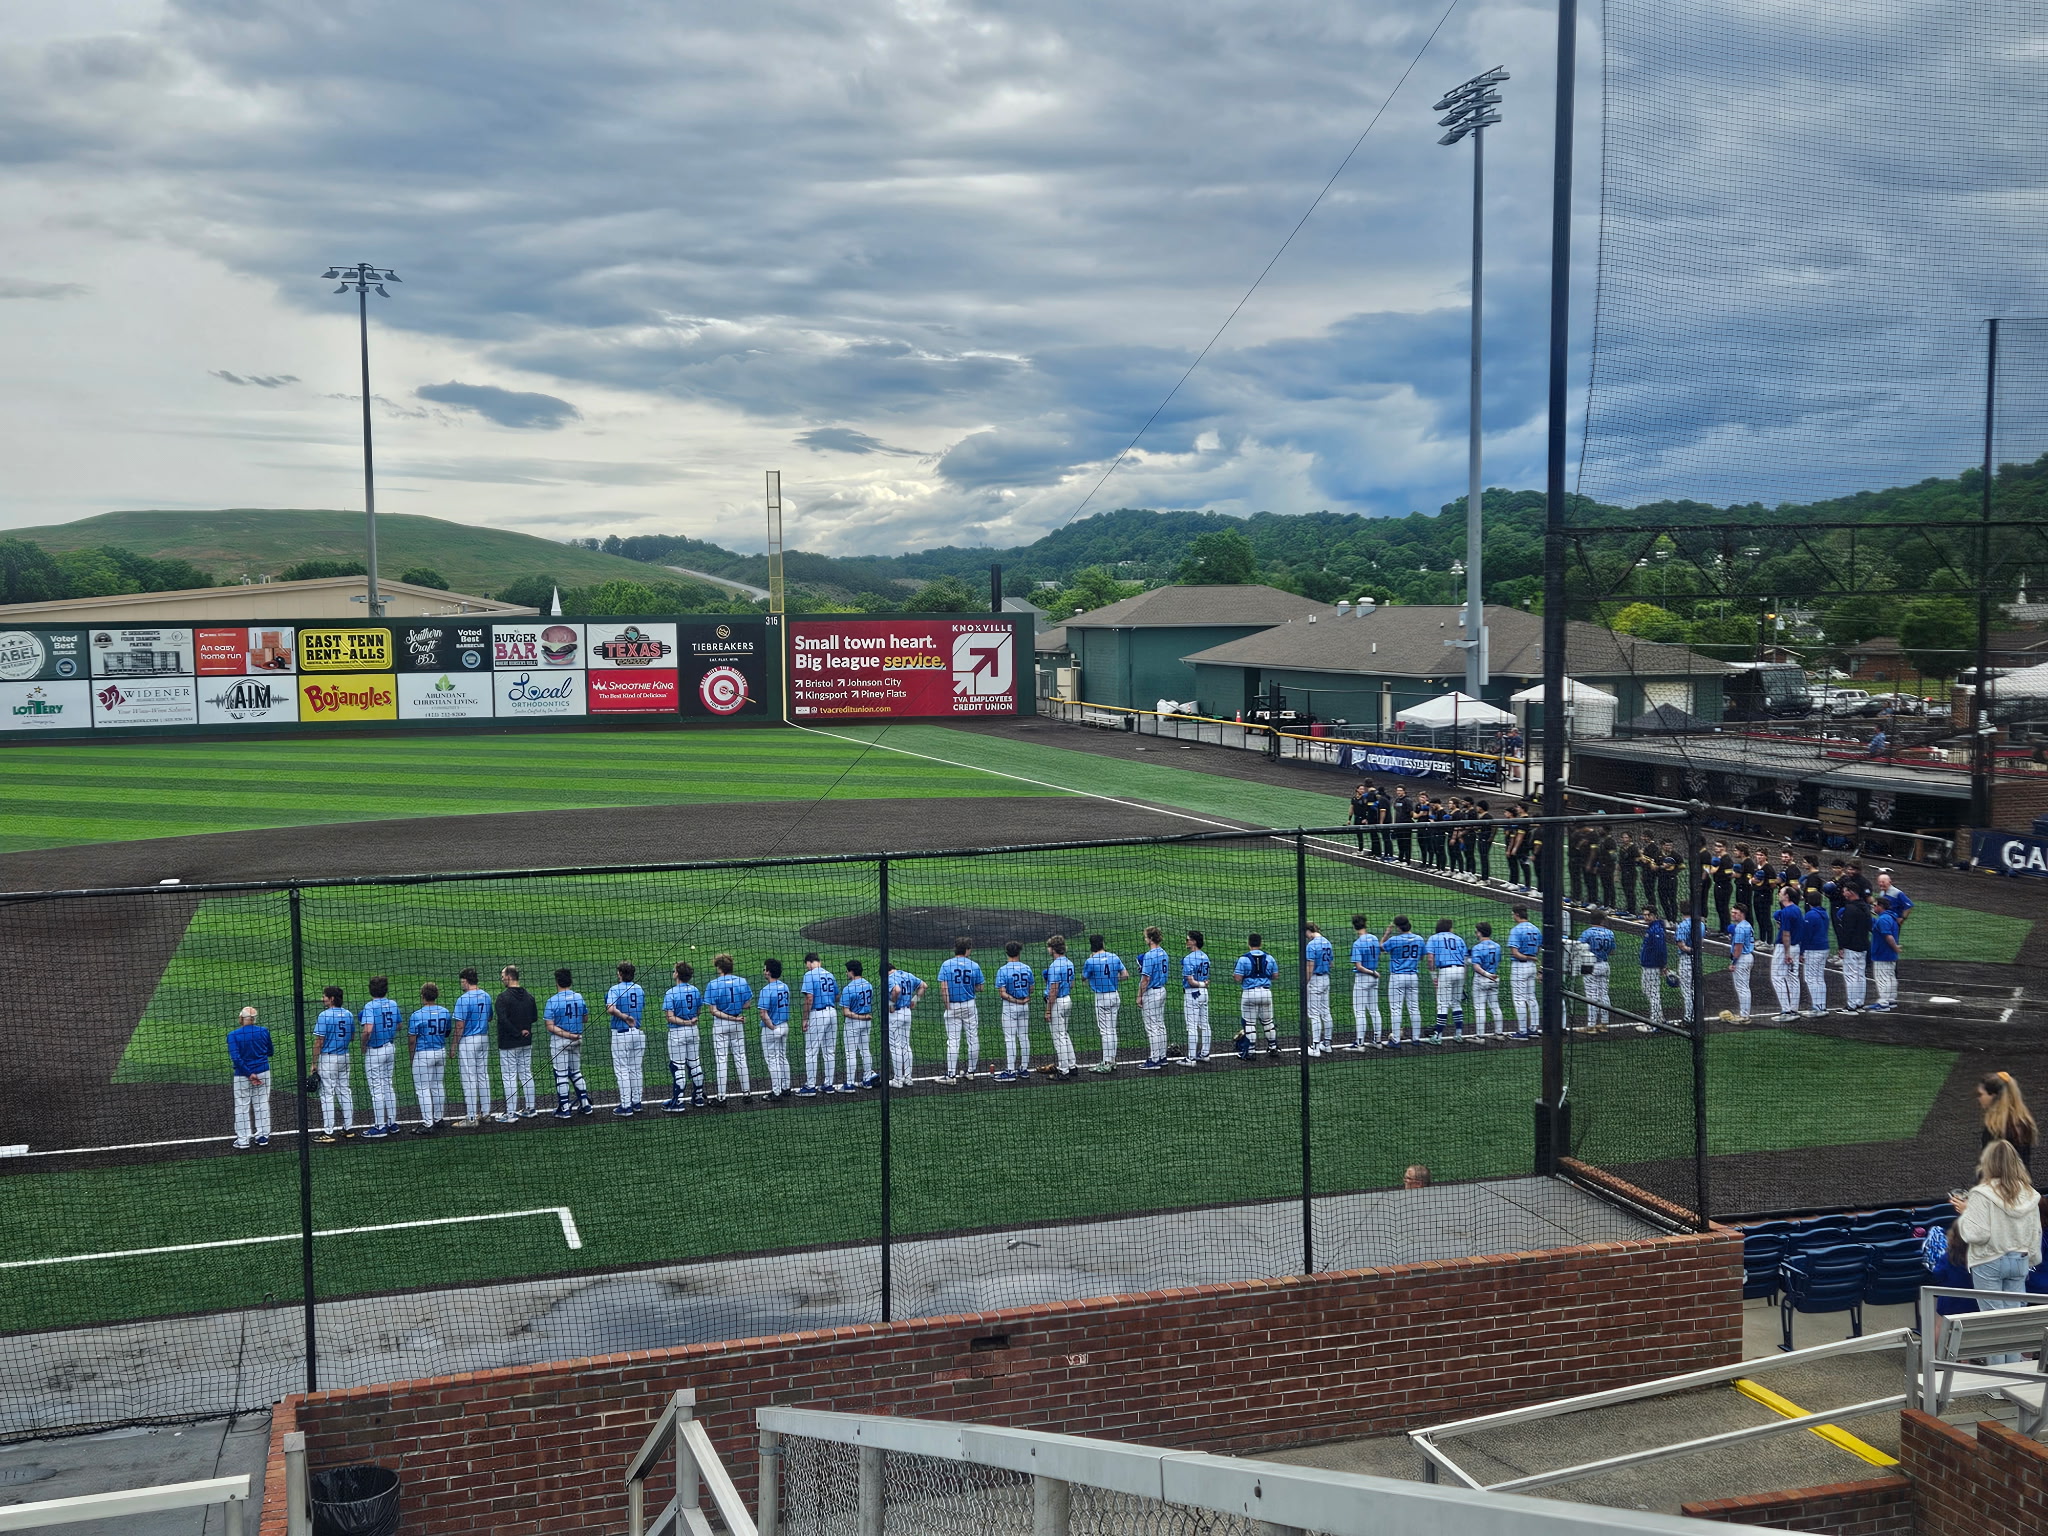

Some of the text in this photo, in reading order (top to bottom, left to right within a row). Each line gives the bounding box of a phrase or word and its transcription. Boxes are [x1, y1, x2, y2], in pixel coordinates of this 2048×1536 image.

[405, 628, 443, 644] Southern
[457, 628, 482, 636] Voted
[494, 633, 537, 642] BURGER
[305, 634, 384, 648] EAST TENN
[410, 640, 439, 654] Craft
[692, 642, 754, 651] TIEBREAKERS
[795, 634, 937, 650] Small town heart.
[306, 648, 385, 661] RENT-ALLS
[494, 642, 537, 660] BAR
[605, 642, 660, 657] TEXAS
[795, 652, 946, 671] Big league service.
[508, 673, 573, 701] Local
[805, 677, 902, 688] Bristol Johnson City
[123, 688, 190, 698] WIDENER
[304, 684, 391, 713] Bojangles
[805, 689, 907, 700] Kingsport Piney Flats
[820, 705, 892, 714] tvacreditunion.com
[2002, 840, 2048, 871] GA
[1402, 944, 1419, 959] 28
[1443, 937, 1456, 951] 10
[1103, 964, 1111, 979] 4
[1161, 959, 1167, 974] 6
[953, 968, 971, 984] 26
[1012, 973, 1029, 989] 25
[820, 976, 834, 993] 22
[630, 992, 637, 1008] 9
[729, 987, 735, 1004] 1
[477, 1003, 485, 1014] 7
[565, 1002, 578, 1019] 41
[382, 1011, 394, 1028] 15
[427, 1018, 447, 1035] 50
[338, 1020, 346, 1038] 5
